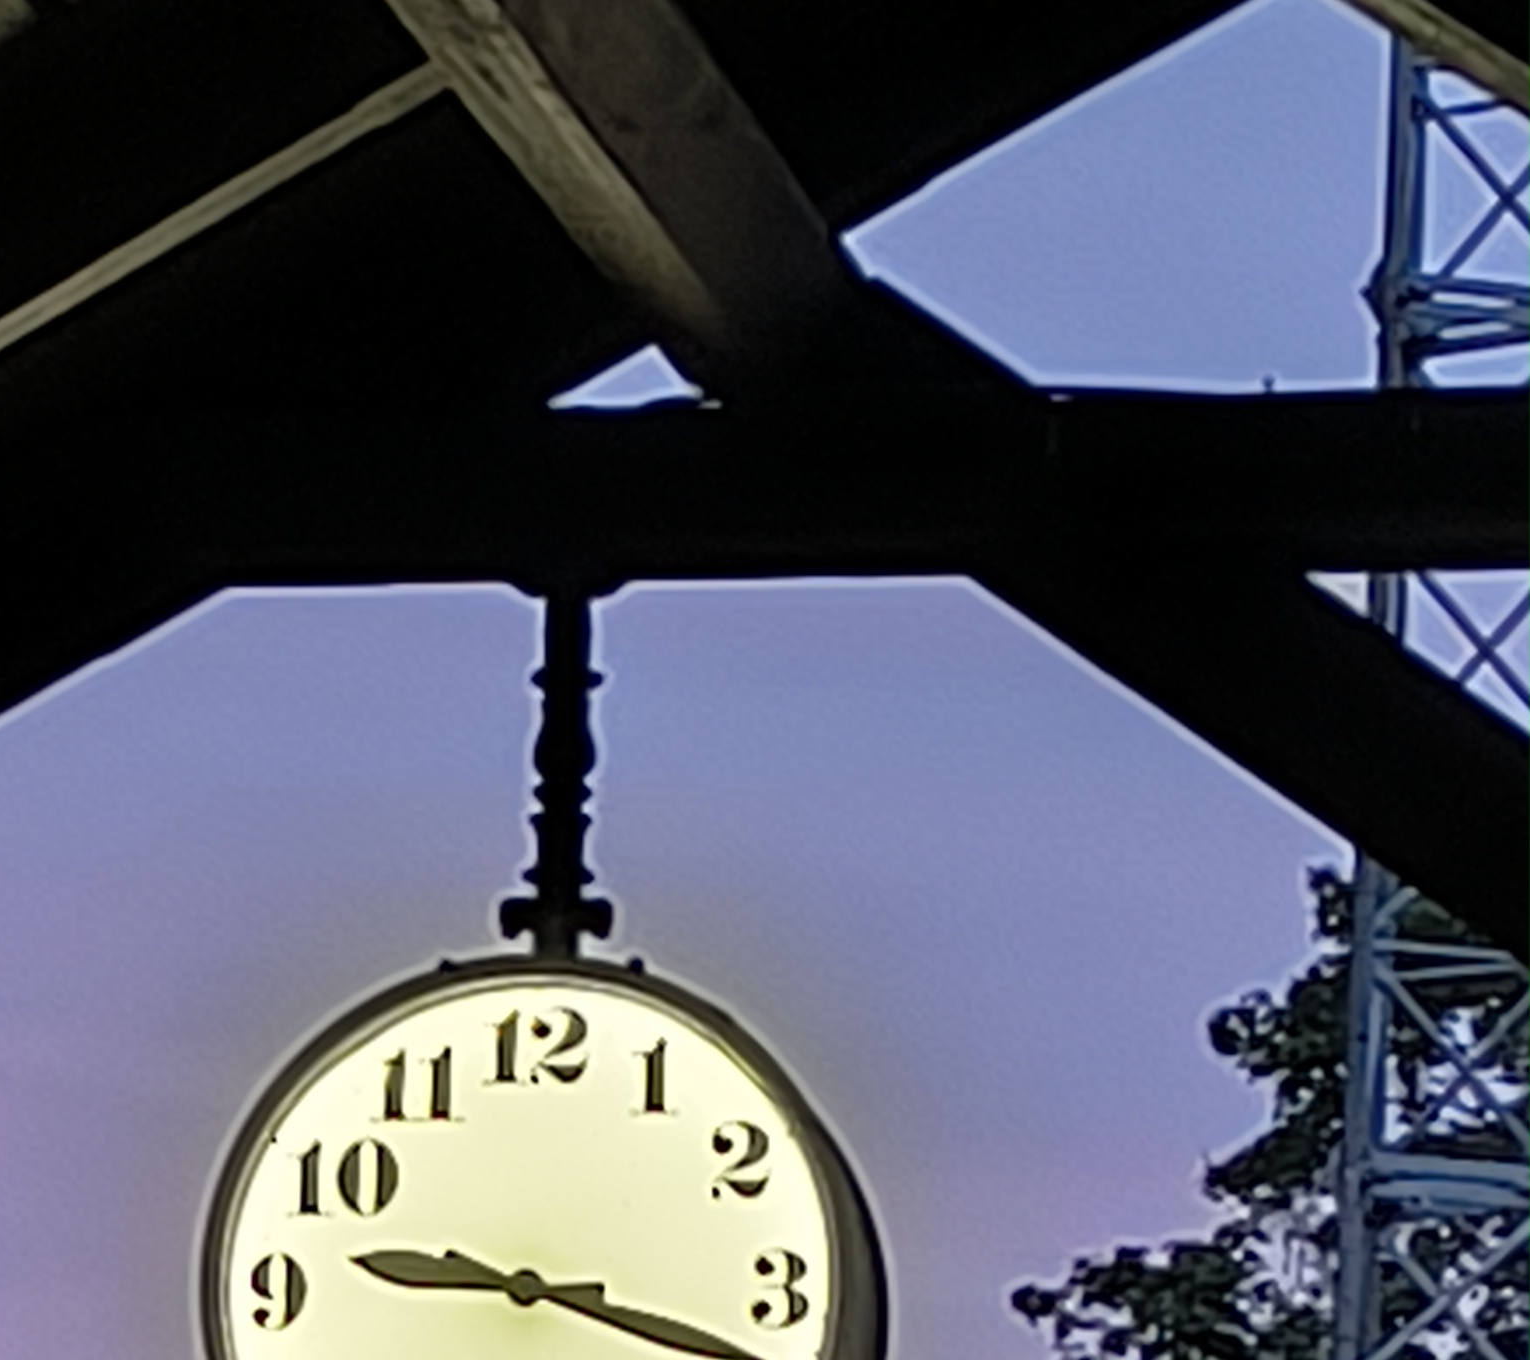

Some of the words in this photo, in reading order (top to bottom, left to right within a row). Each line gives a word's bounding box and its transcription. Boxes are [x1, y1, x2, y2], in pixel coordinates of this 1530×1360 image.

[371, 1046, 465, 1123] 11
[482, 1006, 589, 1085] 12
[629, 1037, 678, 1117] 1
[287, 1137, 400, 1218] 10
[710, 1120, 770, 1201] 2
[250, 1252, 308, 1331] 9
[749, 1248, 810, 1330] 3
